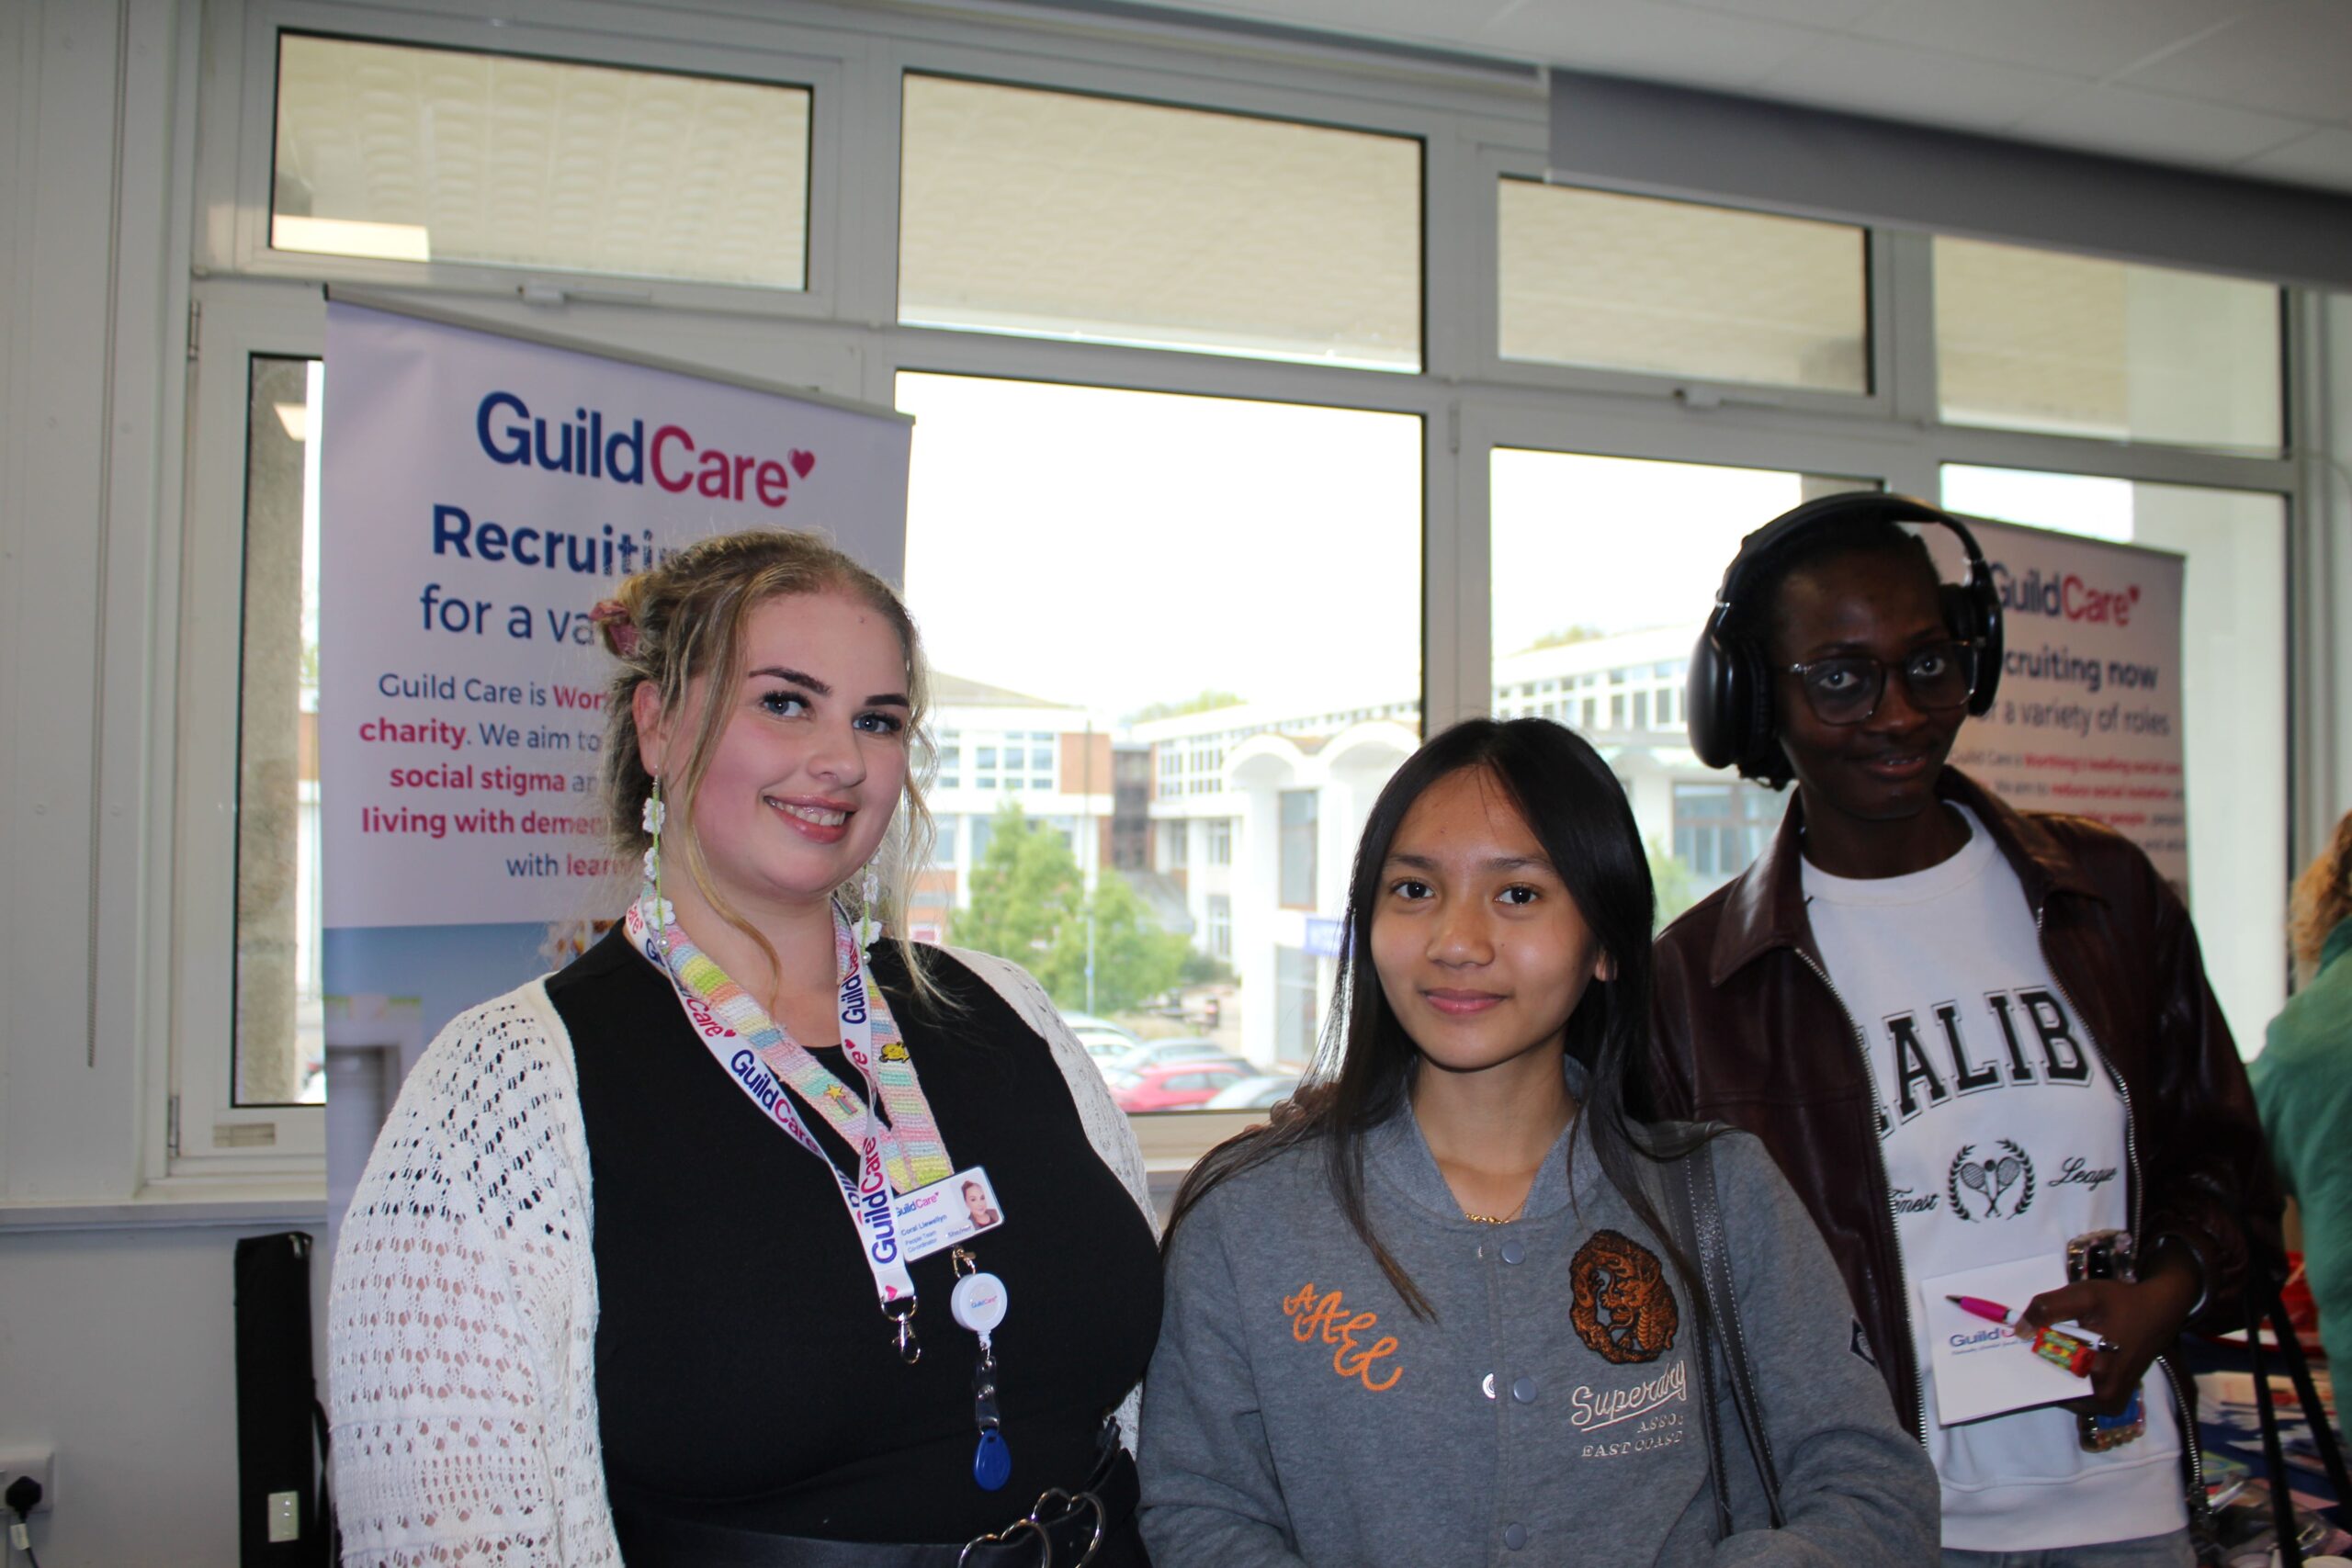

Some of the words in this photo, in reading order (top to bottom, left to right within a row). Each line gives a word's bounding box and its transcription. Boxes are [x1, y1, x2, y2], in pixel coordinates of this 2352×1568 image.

[476, 391, 790, 509] GuildCare
[432, 503, 663, 577] Recruiti
[419, 583, 492, 635] for
[507, 605, 533, 640] a
[378, 672, 456, 701] Guild
[464, 678, 523, 705] Care
[530, 682, 547, 706] is
[2005, 645, 2101, 693] cruiting
[2108, 660, 2158, 690] now
[359, 716, 472, 750] charity.
[479, 722, 520, 749] We
[526, 727, 571, 750] aim
[578, 730, 603, 751] to
[2005, 701, 2017, 725] a
[2022, 696, 2092, 738] variety
[2098, 702, 2120, 731] of
[2124, 707, 2171, 738] roles
[390, 762, 474, 789] social
[481, 765, 566, 797] stigma
[362, 807, 447, 839] living
[454, 808, 515, 834] with
[506, 852, 560, 877] with
[730, 1049, 819, 1154] GuildCare
[861, 1136, 898, 1264] GuildCare
[1571, 1359, 1688, 1426] Superdry
[1581, 1441, 1632, 1457] EAST
[1634, 1430, 1683, 1451] COAST
